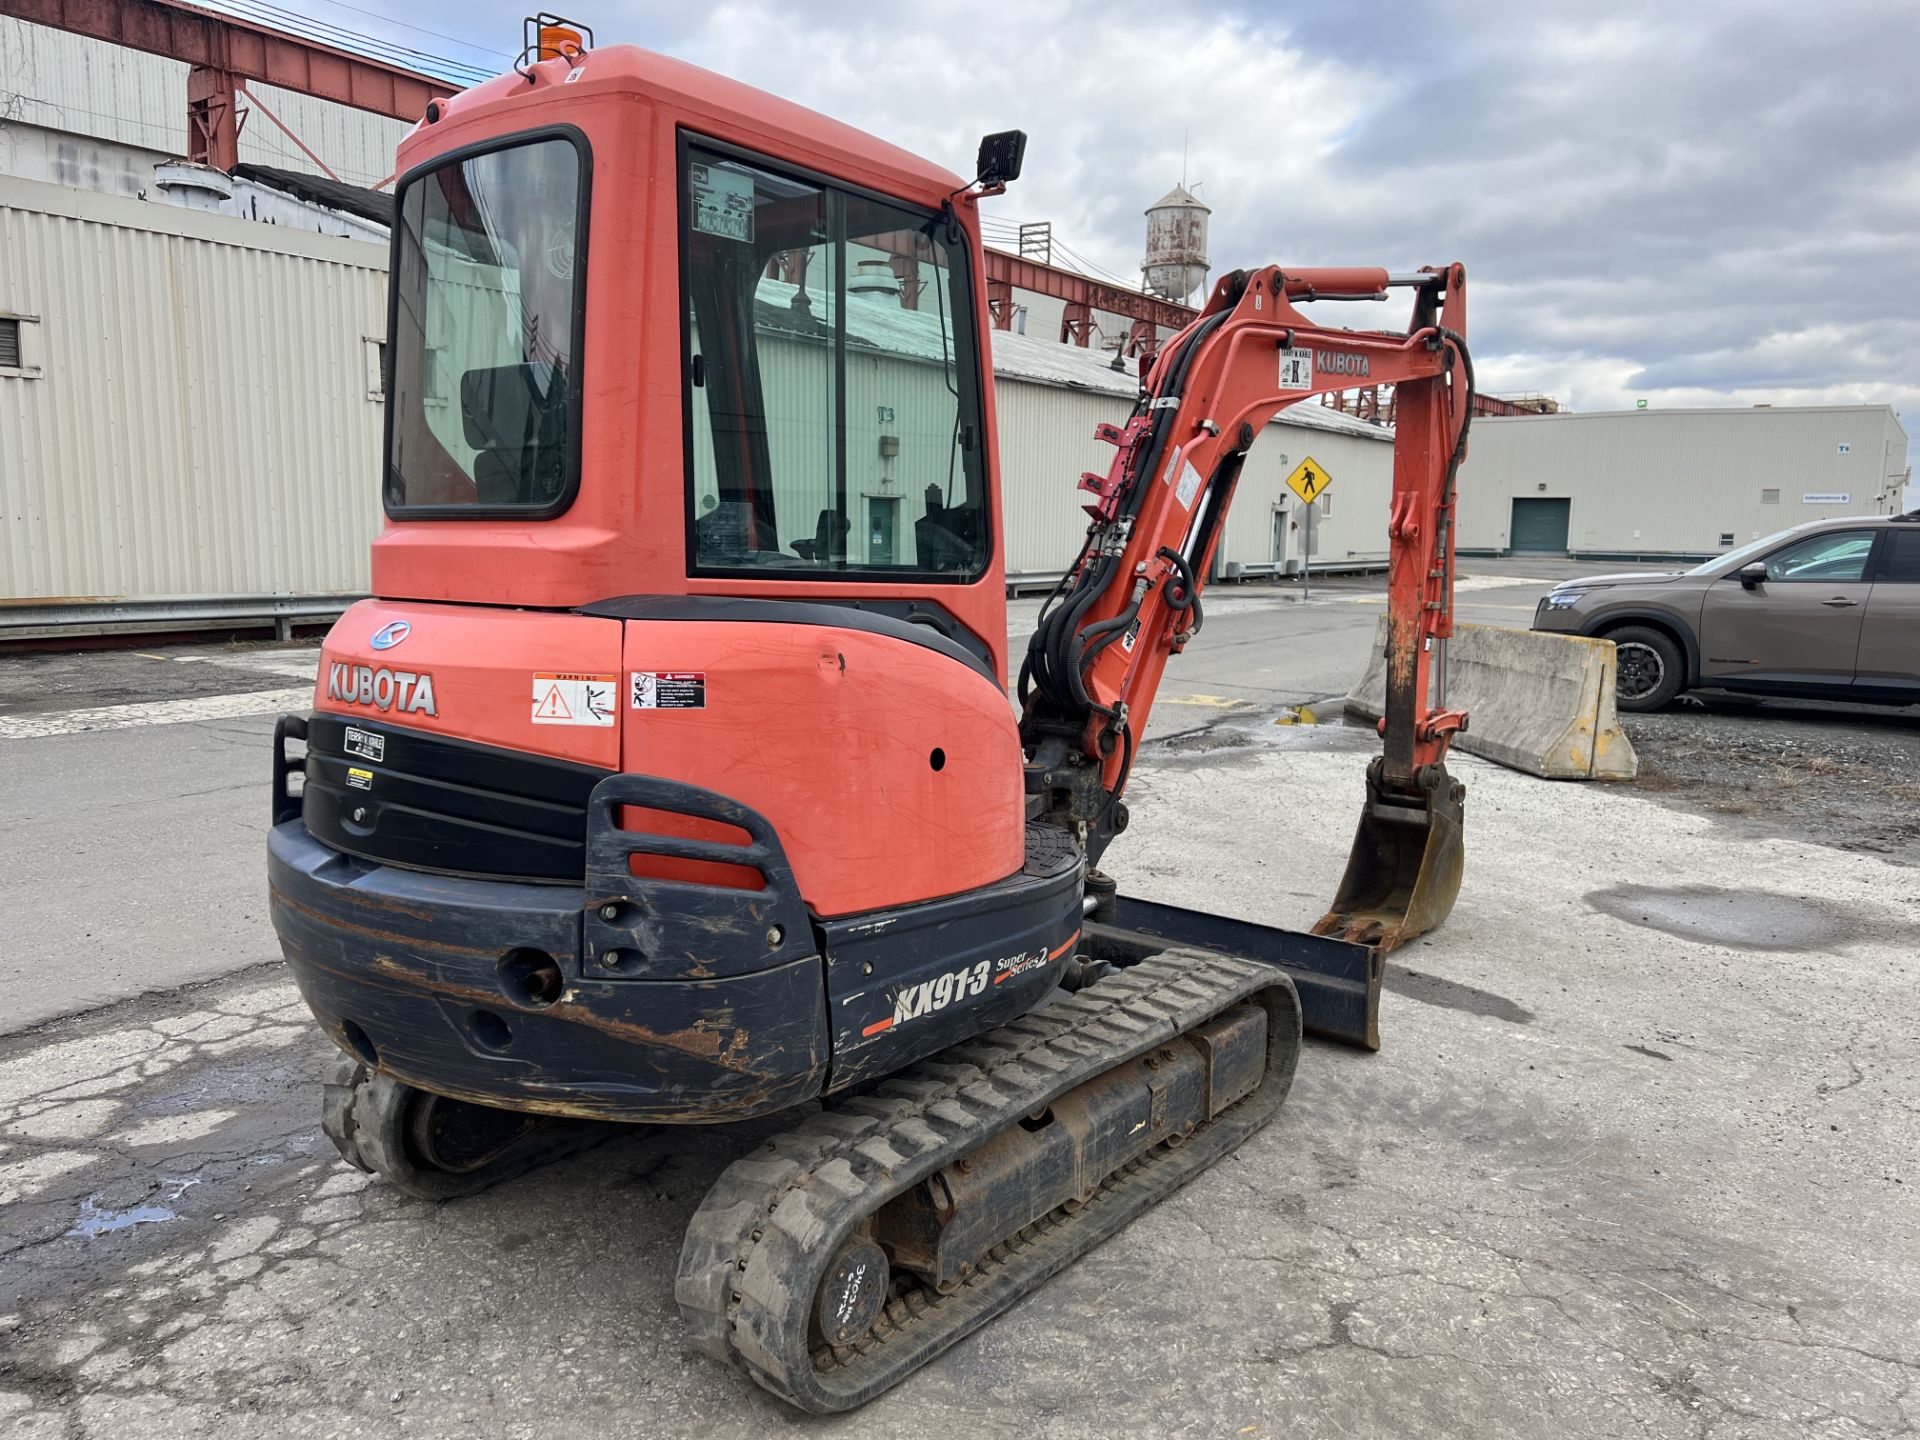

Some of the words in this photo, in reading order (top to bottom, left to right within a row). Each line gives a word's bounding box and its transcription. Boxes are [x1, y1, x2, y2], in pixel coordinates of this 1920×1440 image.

[1316, 350, 1370, 377] KUBOTA
[327, 661, 437, 716] KUBOTA
[996, 951, 1027, 972] Super
[1010, 957, 1039, 977] Series
[1036, 947, 1048, 969] 2
[892, 959, 991, 1026] KX91-3
[849, 1264, 866, 1304] 3403
